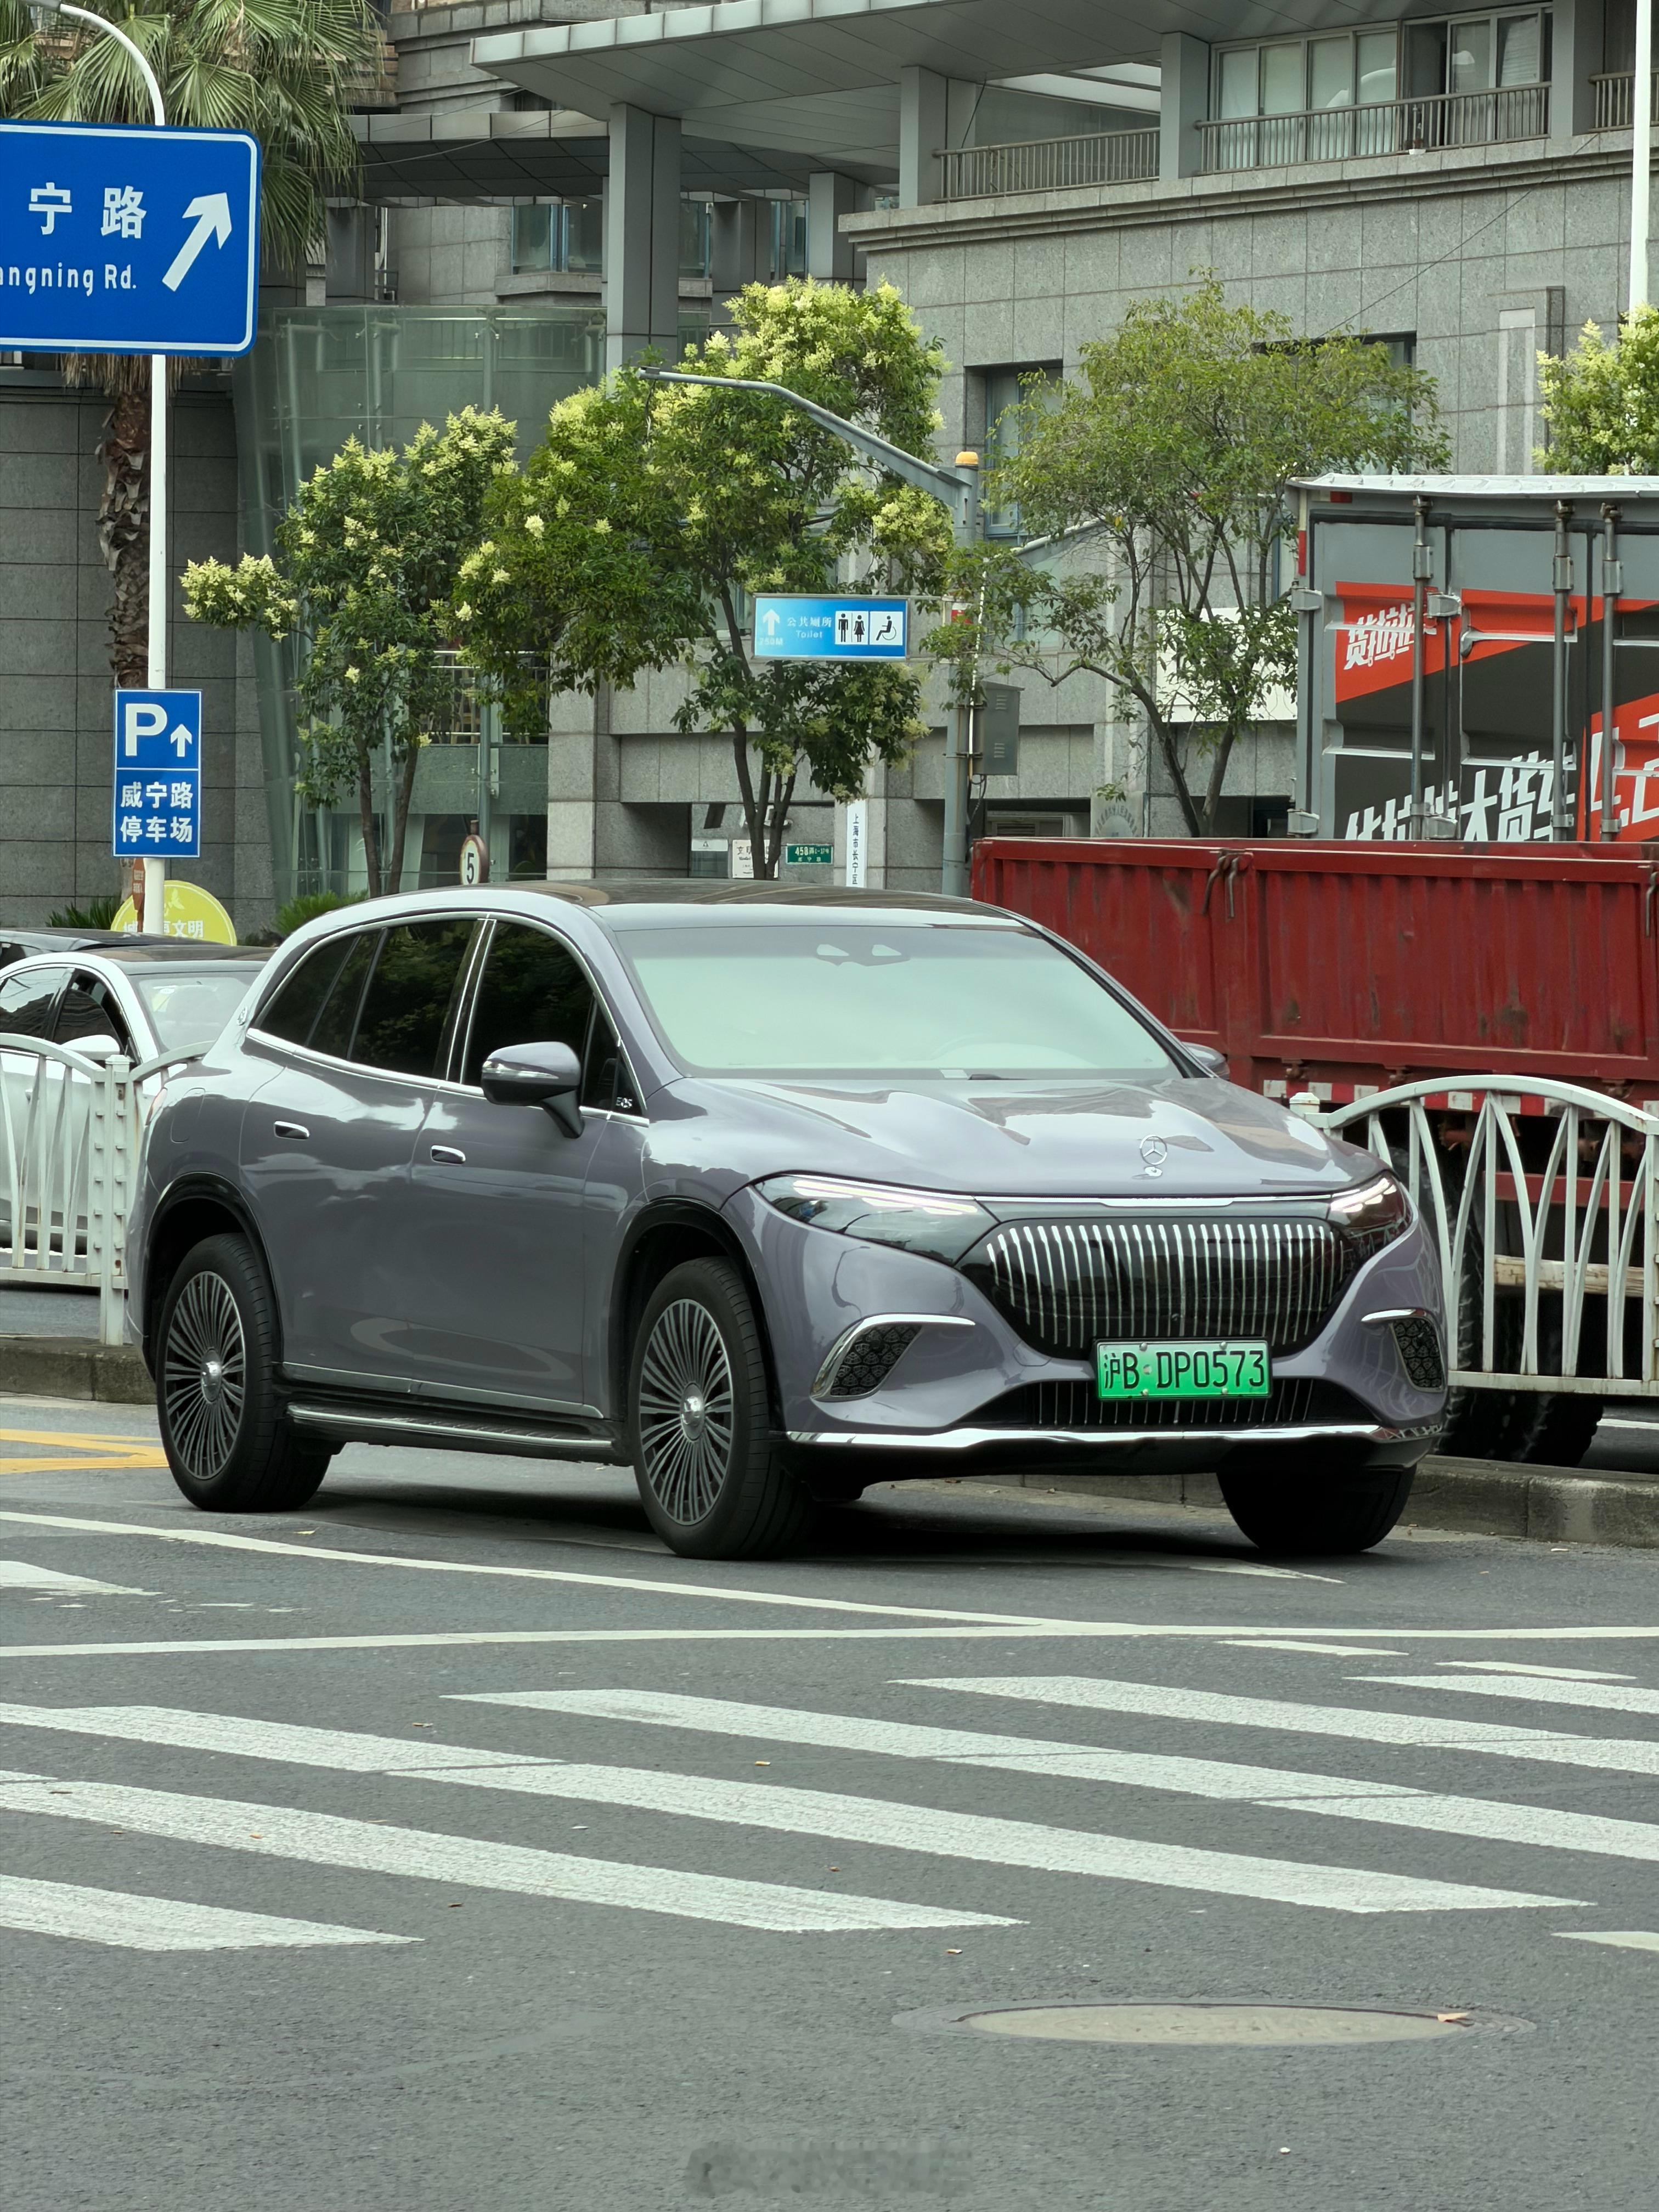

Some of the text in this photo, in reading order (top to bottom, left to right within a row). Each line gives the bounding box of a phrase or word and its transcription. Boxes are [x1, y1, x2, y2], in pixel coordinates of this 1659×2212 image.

[29, 182, 147, 239] 宁路
[105, 264, 137, 289] Rd.
[787, 616, 832, 628] 公共厕所
[795, 630, 823, 639] Toilet
[125, 703, 168, 757] P
[121, 782, 193, 809] 威宁路
[121, 815, 193, 843] 停车场
[466, 851, 475, 884] 5
